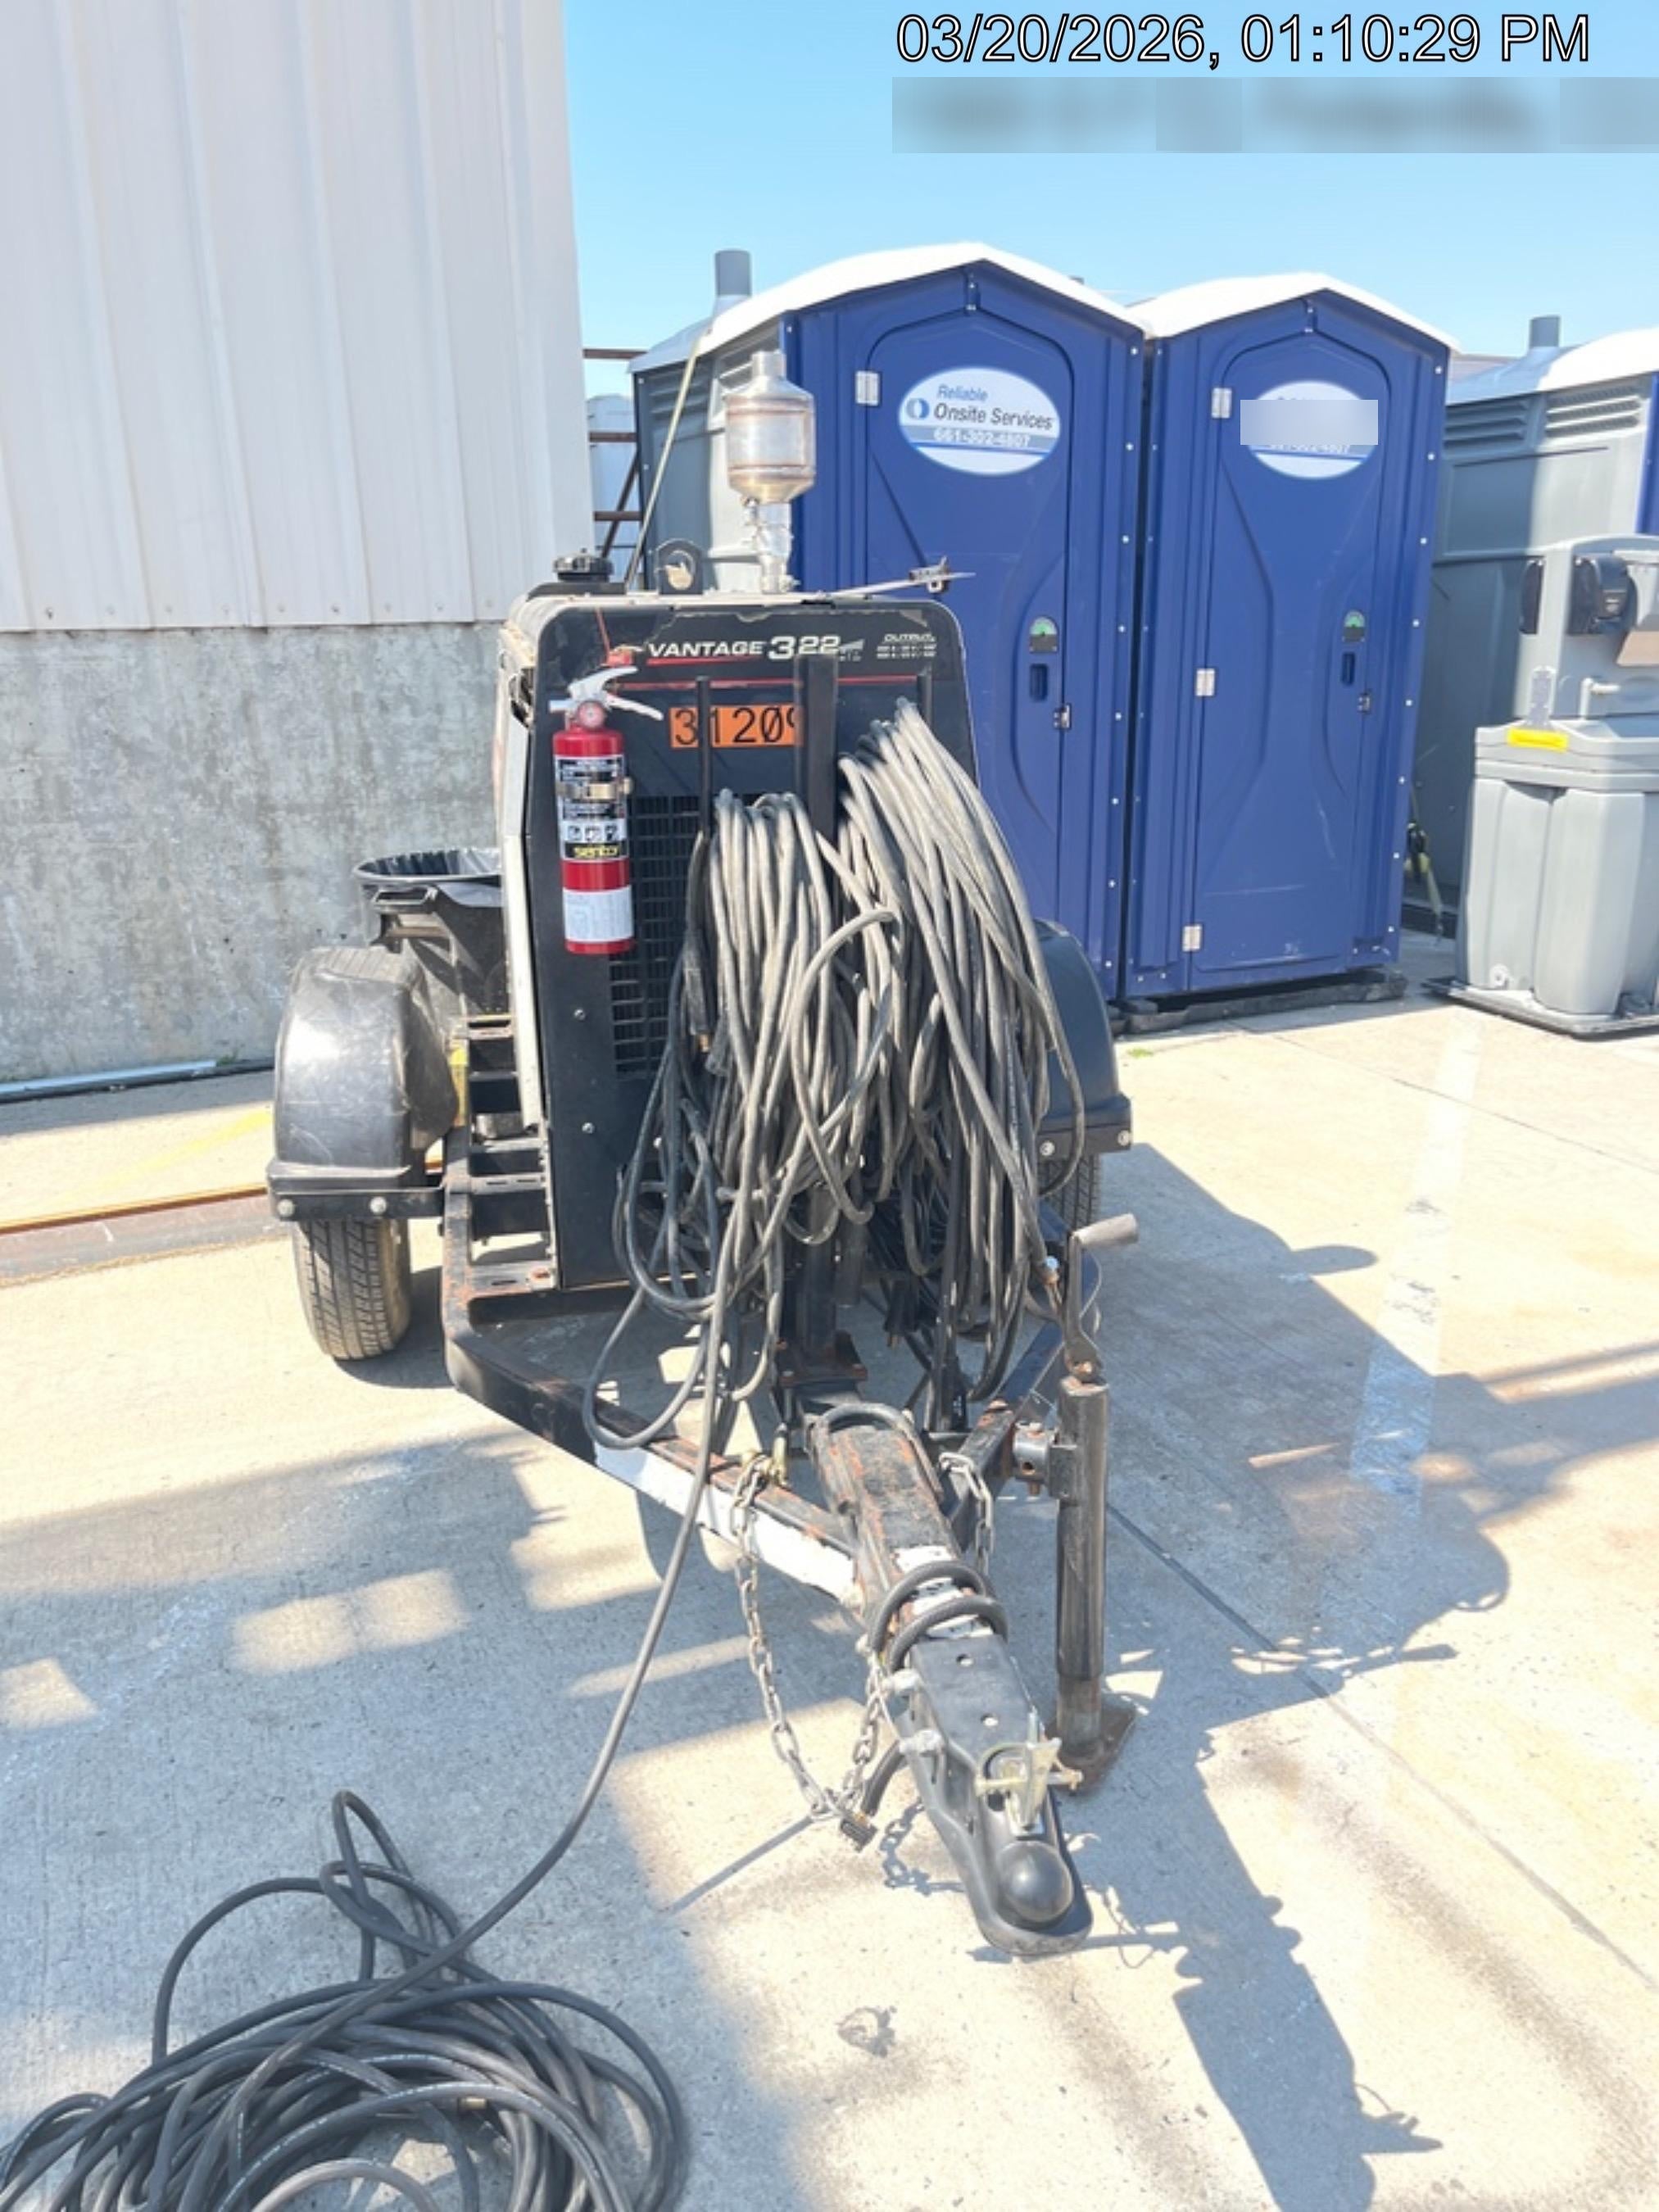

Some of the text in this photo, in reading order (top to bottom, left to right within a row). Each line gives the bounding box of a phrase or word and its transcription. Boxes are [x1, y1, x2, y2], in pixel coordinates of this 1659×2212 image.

[937, 384, 988, 402] Reliable
[934, 402, 1054, 430] Onsite Services
[646, 641, 765, 657] VANTAGE
[768, 635, 841, 660] 322
